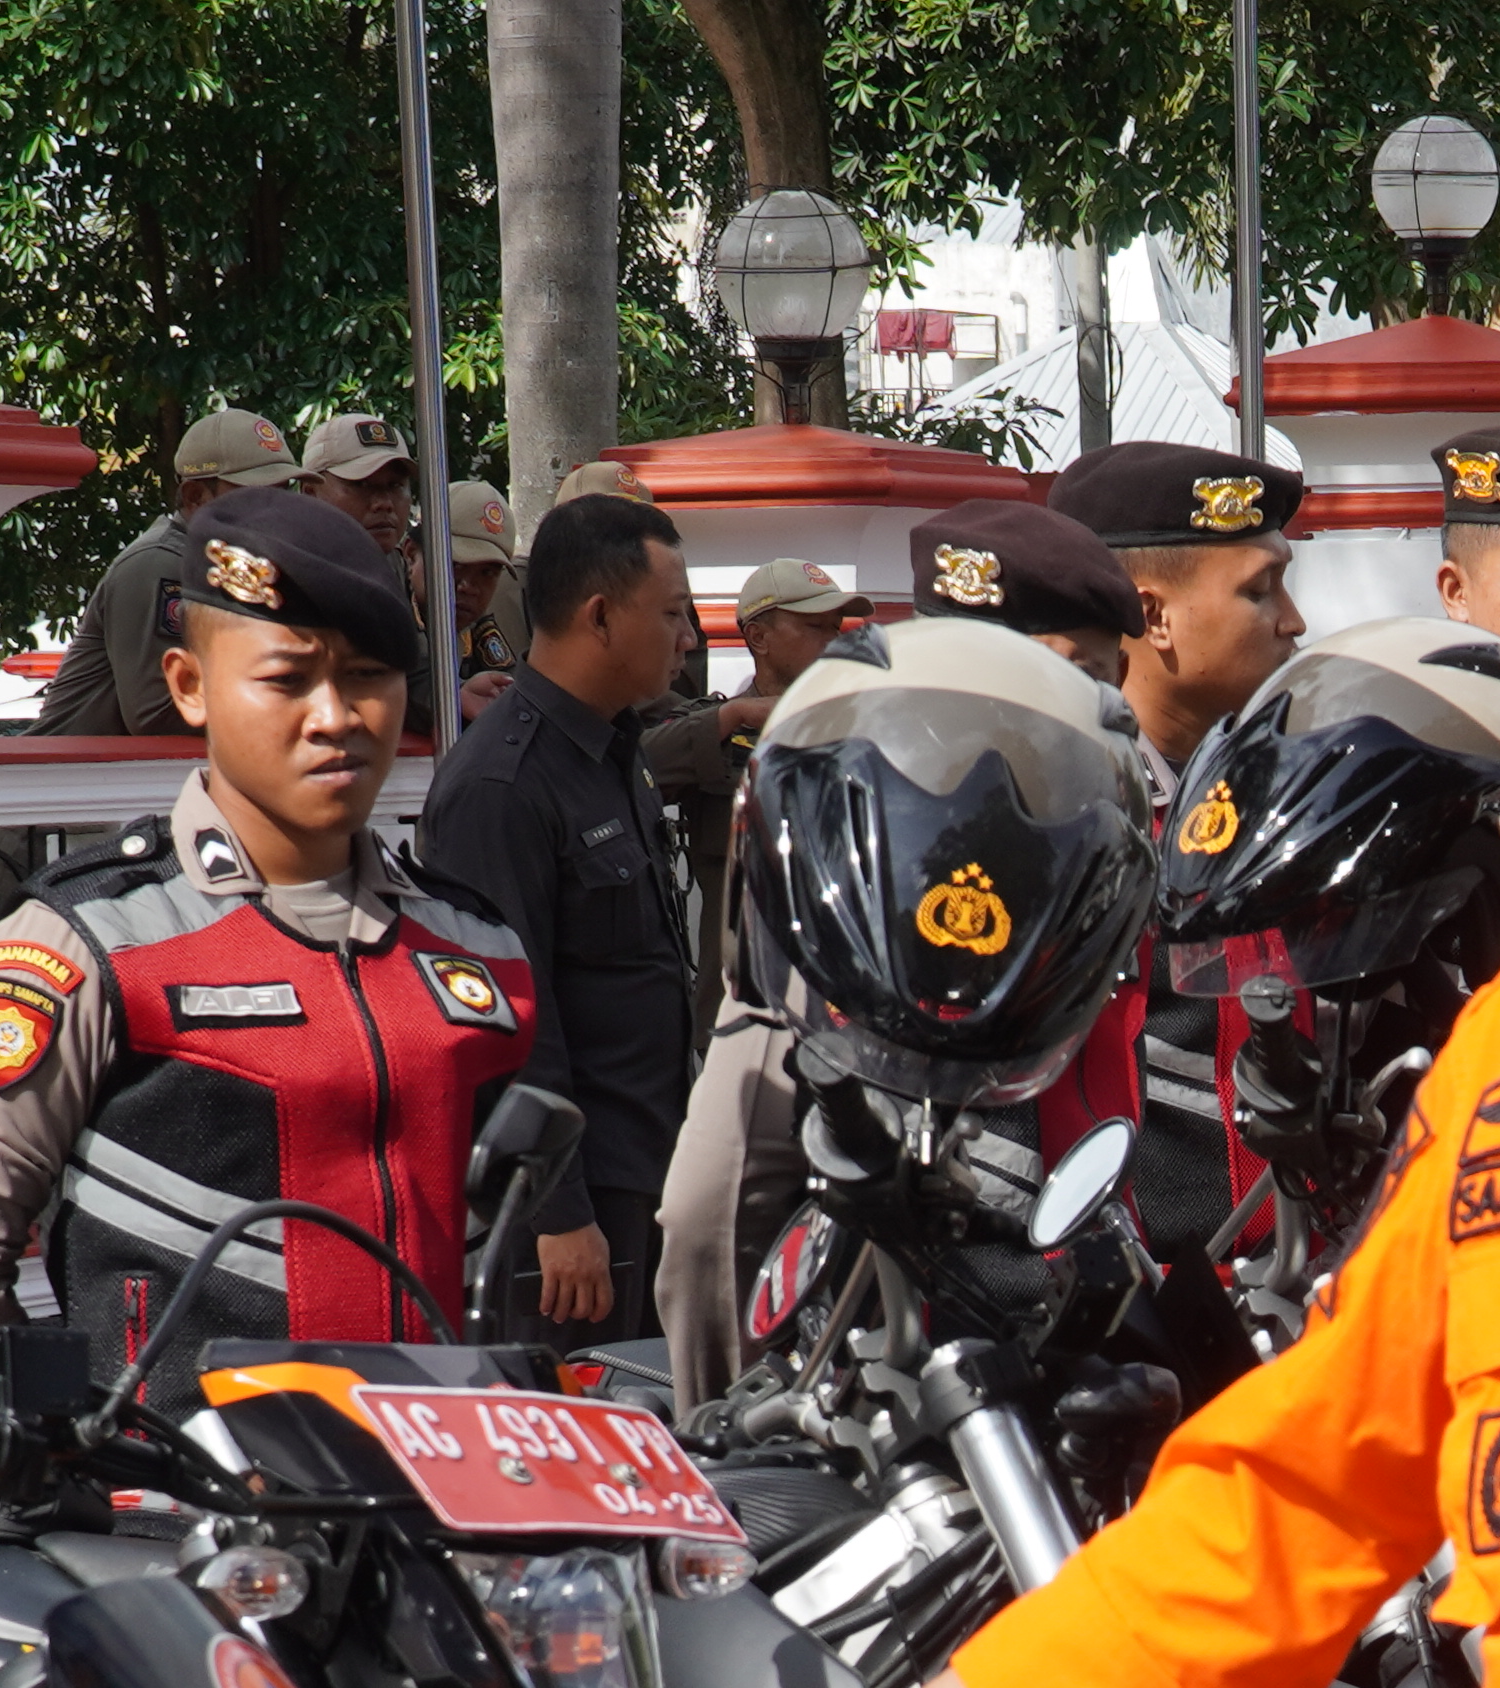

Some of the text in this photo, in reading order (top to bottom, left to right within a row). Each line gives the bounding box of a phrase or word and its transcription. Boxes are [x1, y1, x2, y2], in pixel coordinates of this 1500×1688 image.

[195, 988, 283, 1011] ALFI
[379, 1400, 680, 1474] AG 4931 PP
